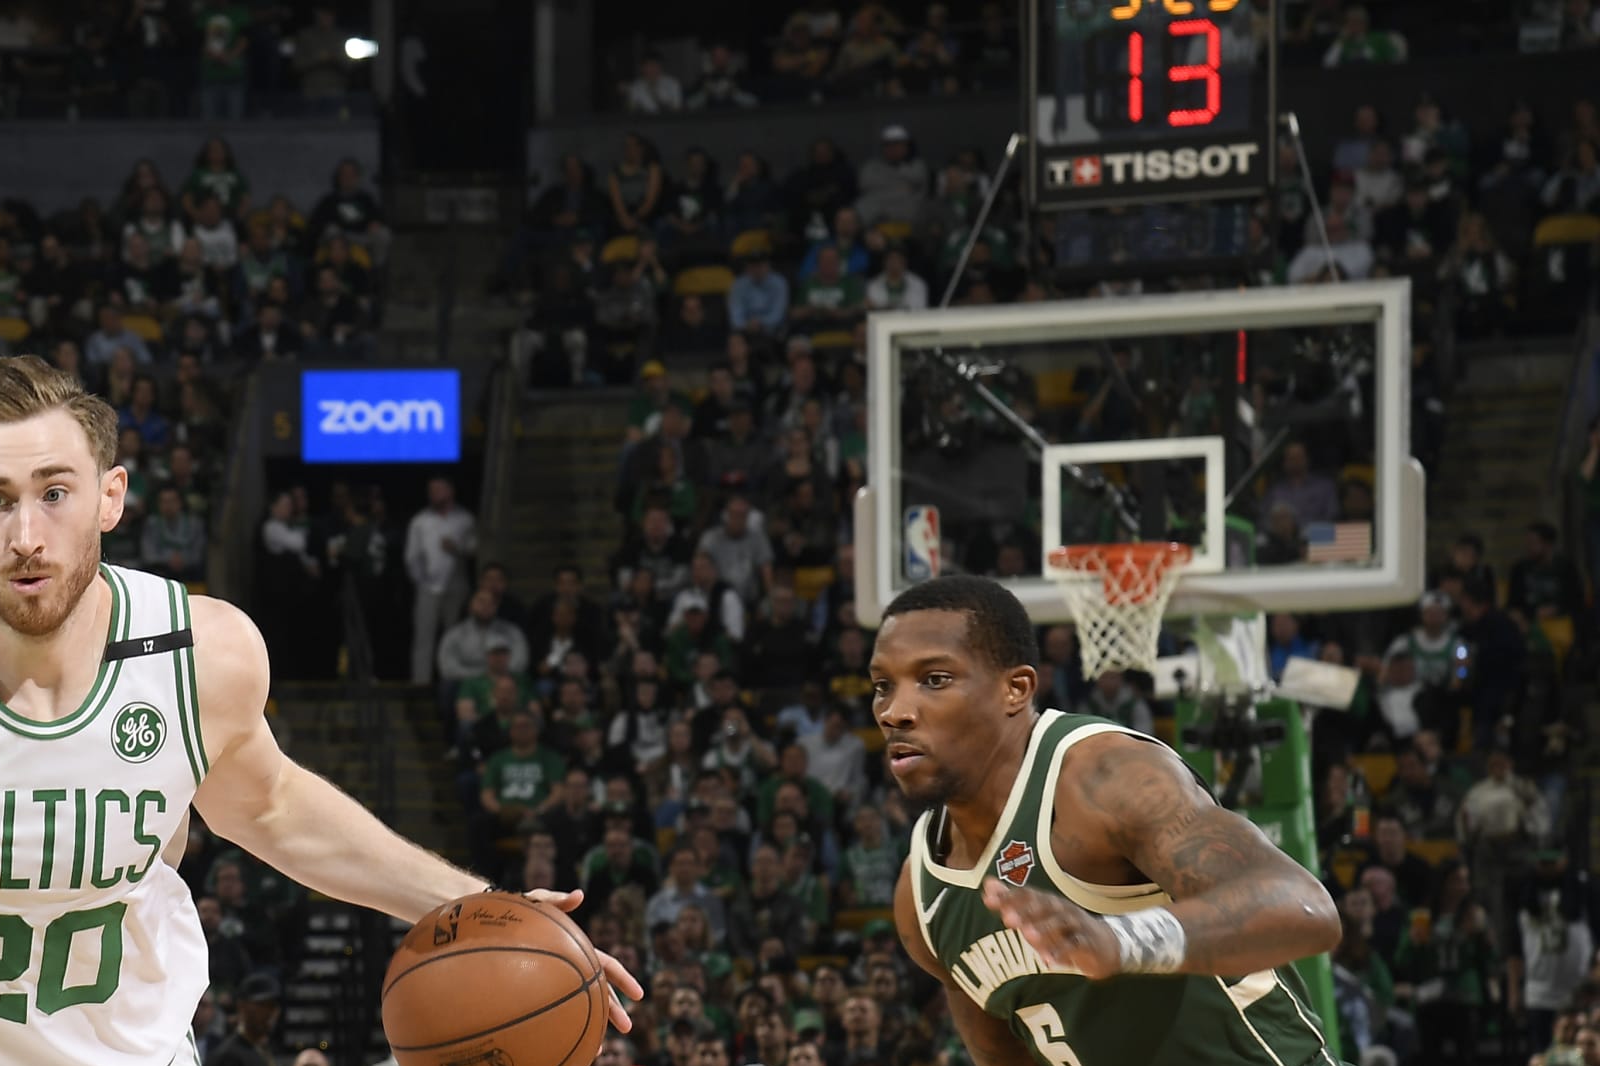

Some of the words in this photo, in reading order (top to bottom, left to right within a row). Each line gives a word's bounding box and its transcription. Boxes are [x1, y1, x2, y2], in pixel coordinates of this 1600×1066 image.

[1128, 18, 1222, 127] 13
[1103, 142, 1259, 184] TISSOT
[318, 400, 443, 433] zoom
[142, 640, 154, 653] 17
